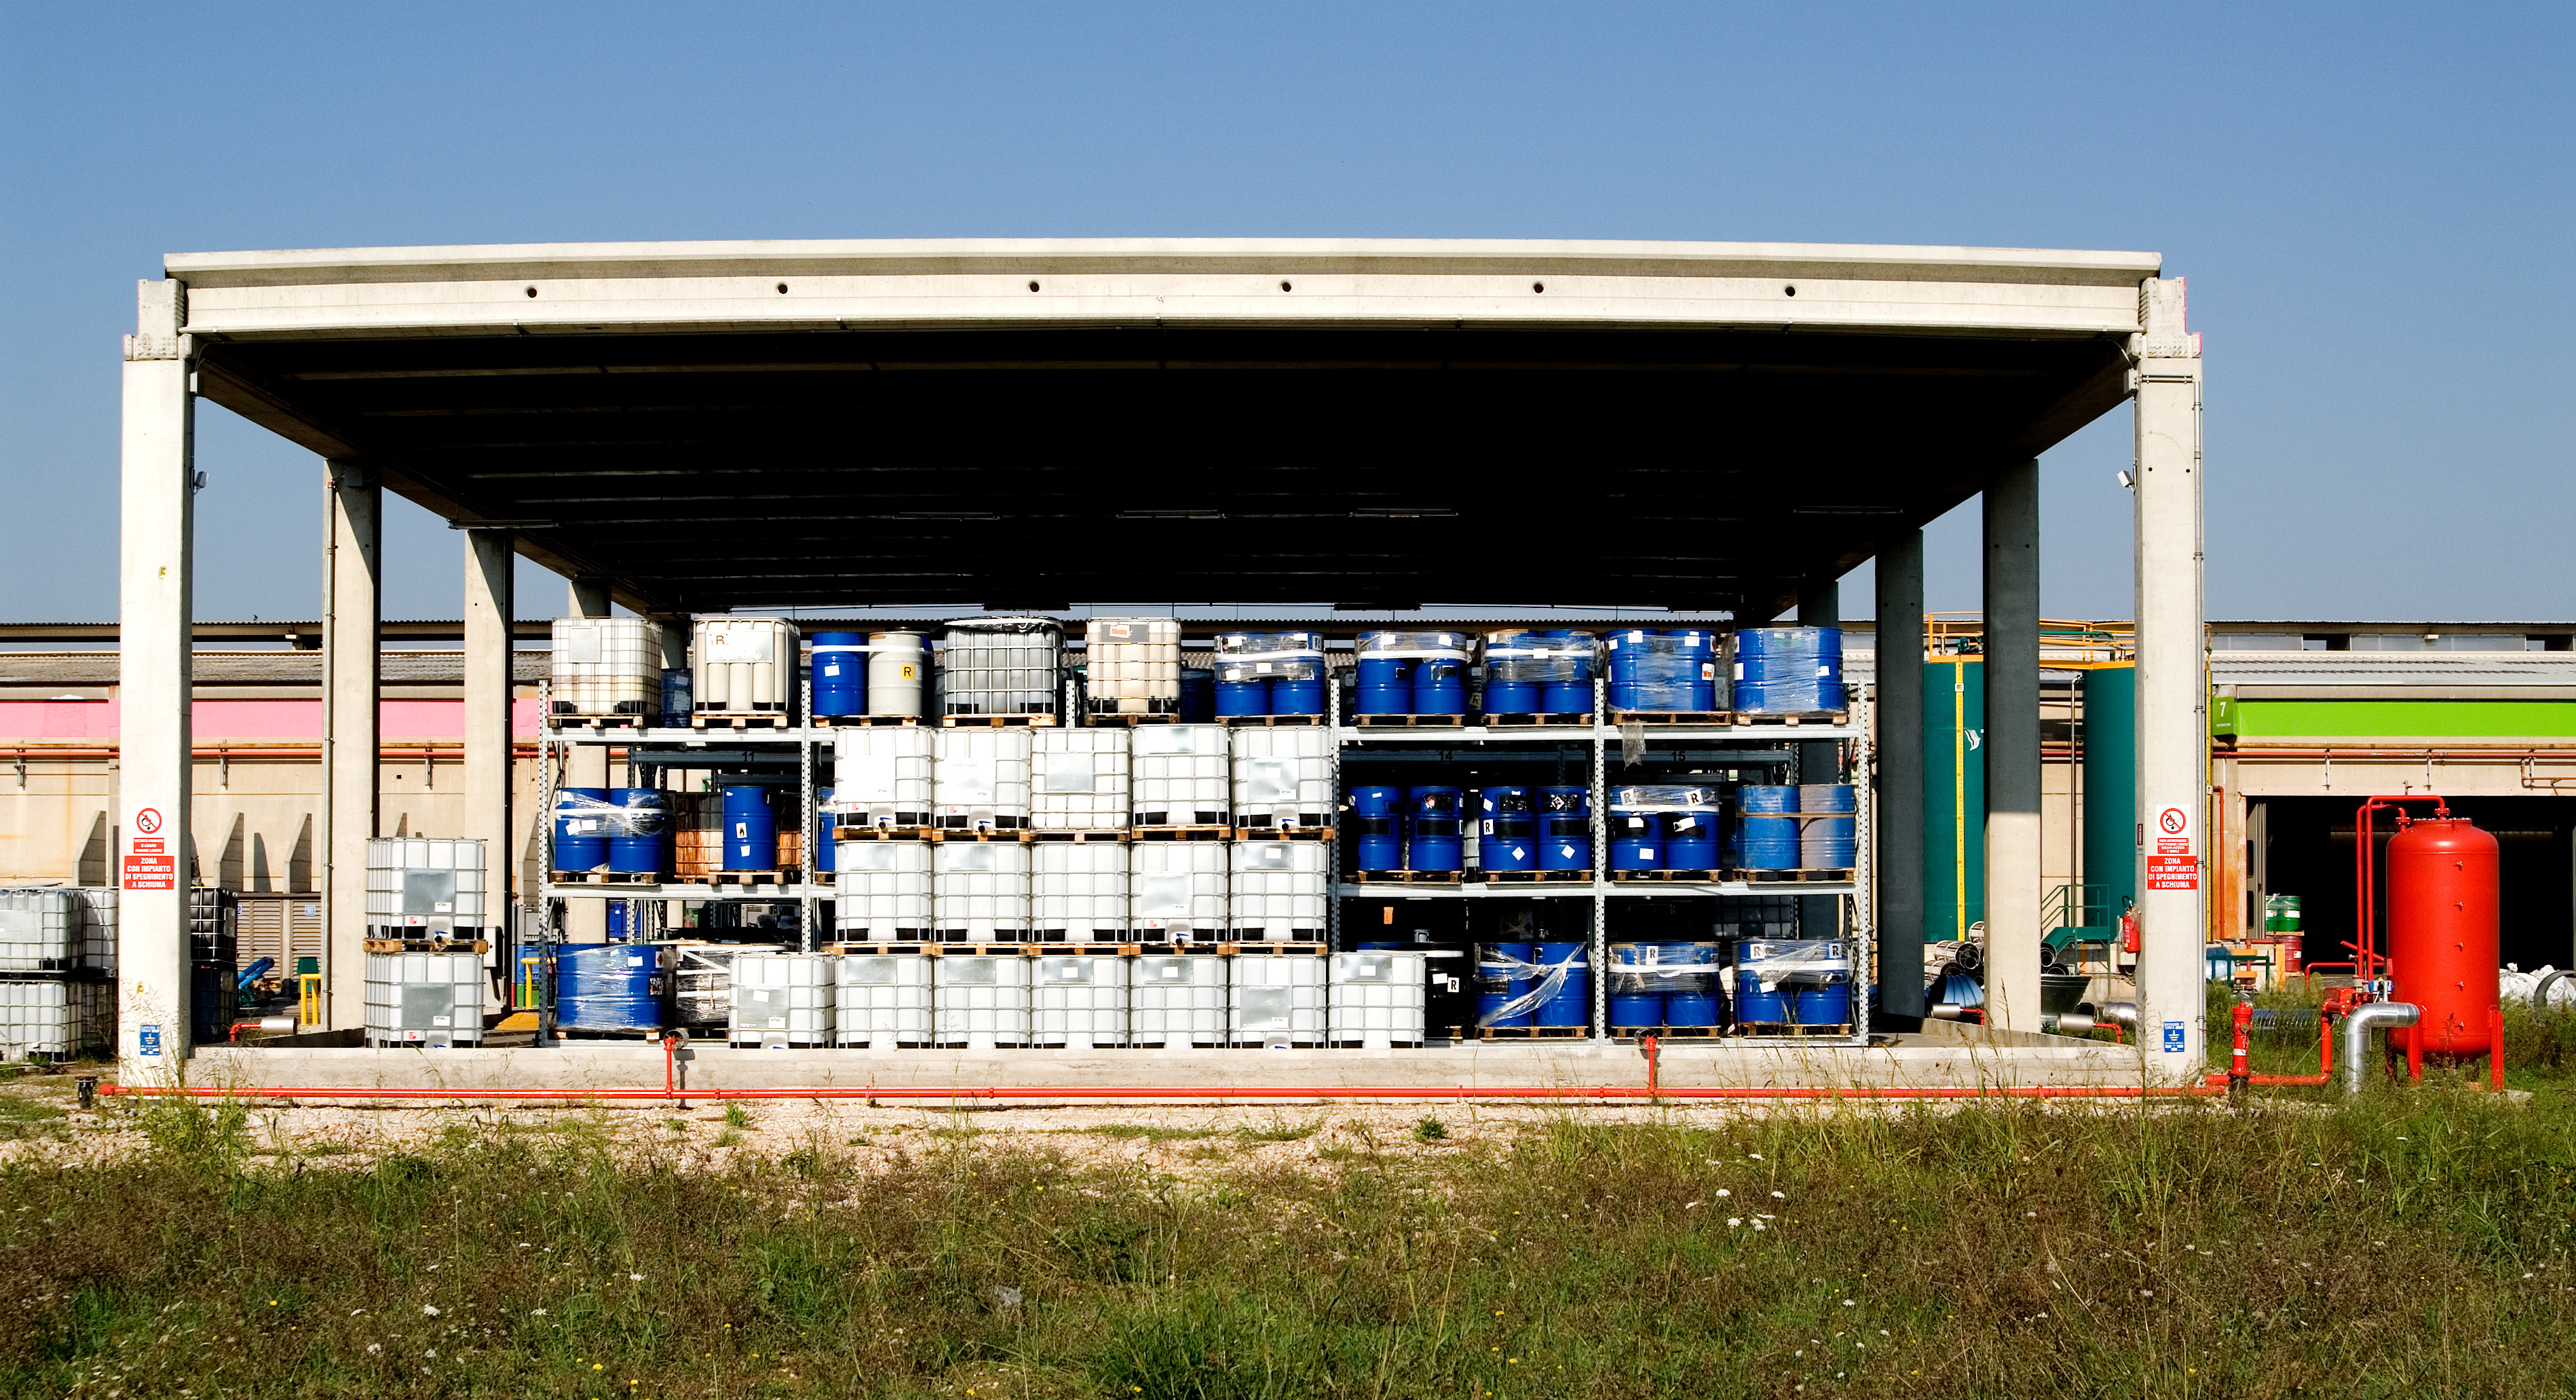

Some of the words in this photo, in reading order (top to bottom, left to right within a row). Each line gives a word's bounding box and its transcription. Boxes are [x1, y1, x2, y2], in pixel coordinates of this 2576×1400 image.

[716, 635, 724, 645] R
[1314, 637, 1321, 649] R
[904, 666, 911, 677] R
[2220, 701, 2227, 717] 7
[742, 751, 754, 761] 11
[1439, 750, 1453, 761] 14
[1671, 751, 1686, 761] 15
[1623, 792, 1631, 803] R
[1690, 793, 1699, 803] R
[1485, 822, 1490, 833] R
[1650, 948, 1656, 958] R
[1754, 946, 1761, 956] R
[1832, 945, 1839, 956] R
[1451, 979, 1456, 990] R
